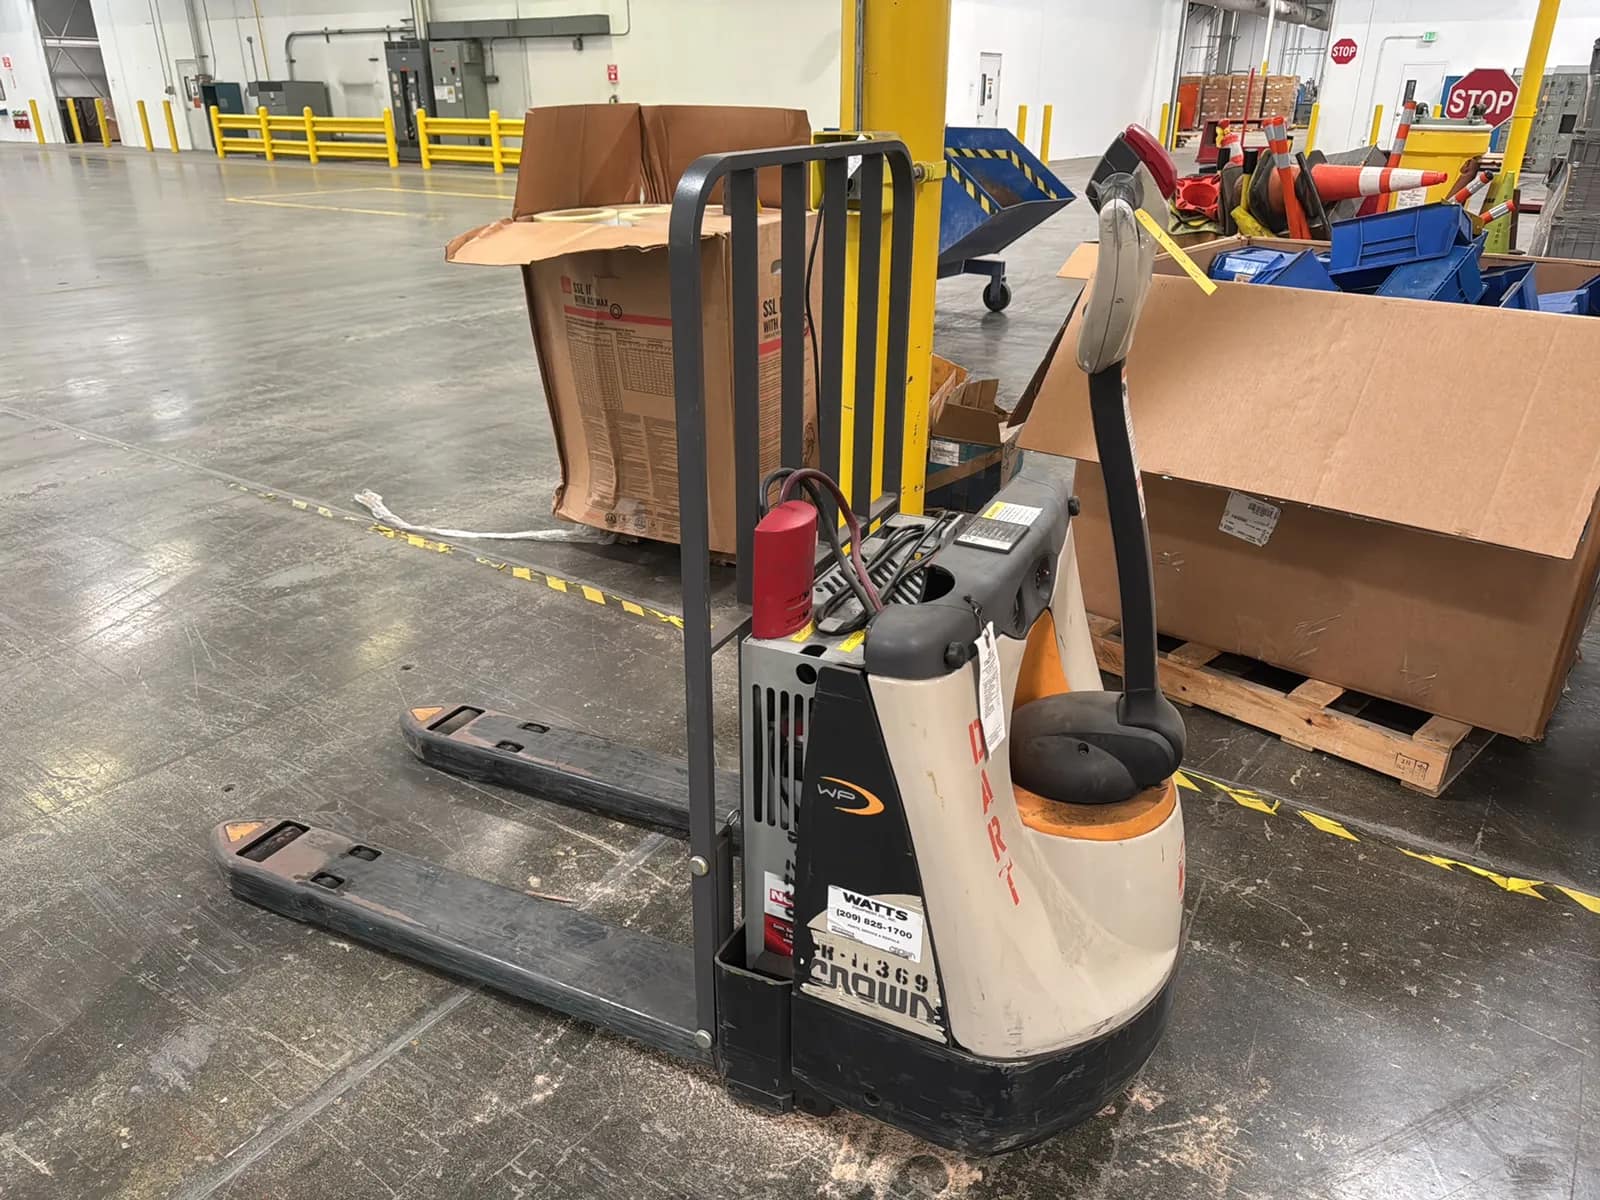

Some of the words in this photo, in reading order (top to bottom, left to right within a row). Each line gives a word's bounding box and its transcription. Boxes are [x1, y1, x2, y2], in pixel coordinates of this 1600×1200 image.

[1332, 46, 1356, 57] STOP
[1449, 89, 1514, 115] STOP
[762, 298, 778, 317] SSL
[763, 319, 779, 334] WITH
[817, 783, 856, 800] WP
[968, 719, 1020, 906] DART
[842, 891, 908, 921] WATTS
[836, 908, 861, 923] (209)
[864, 917, 913, 940] 825-1700
